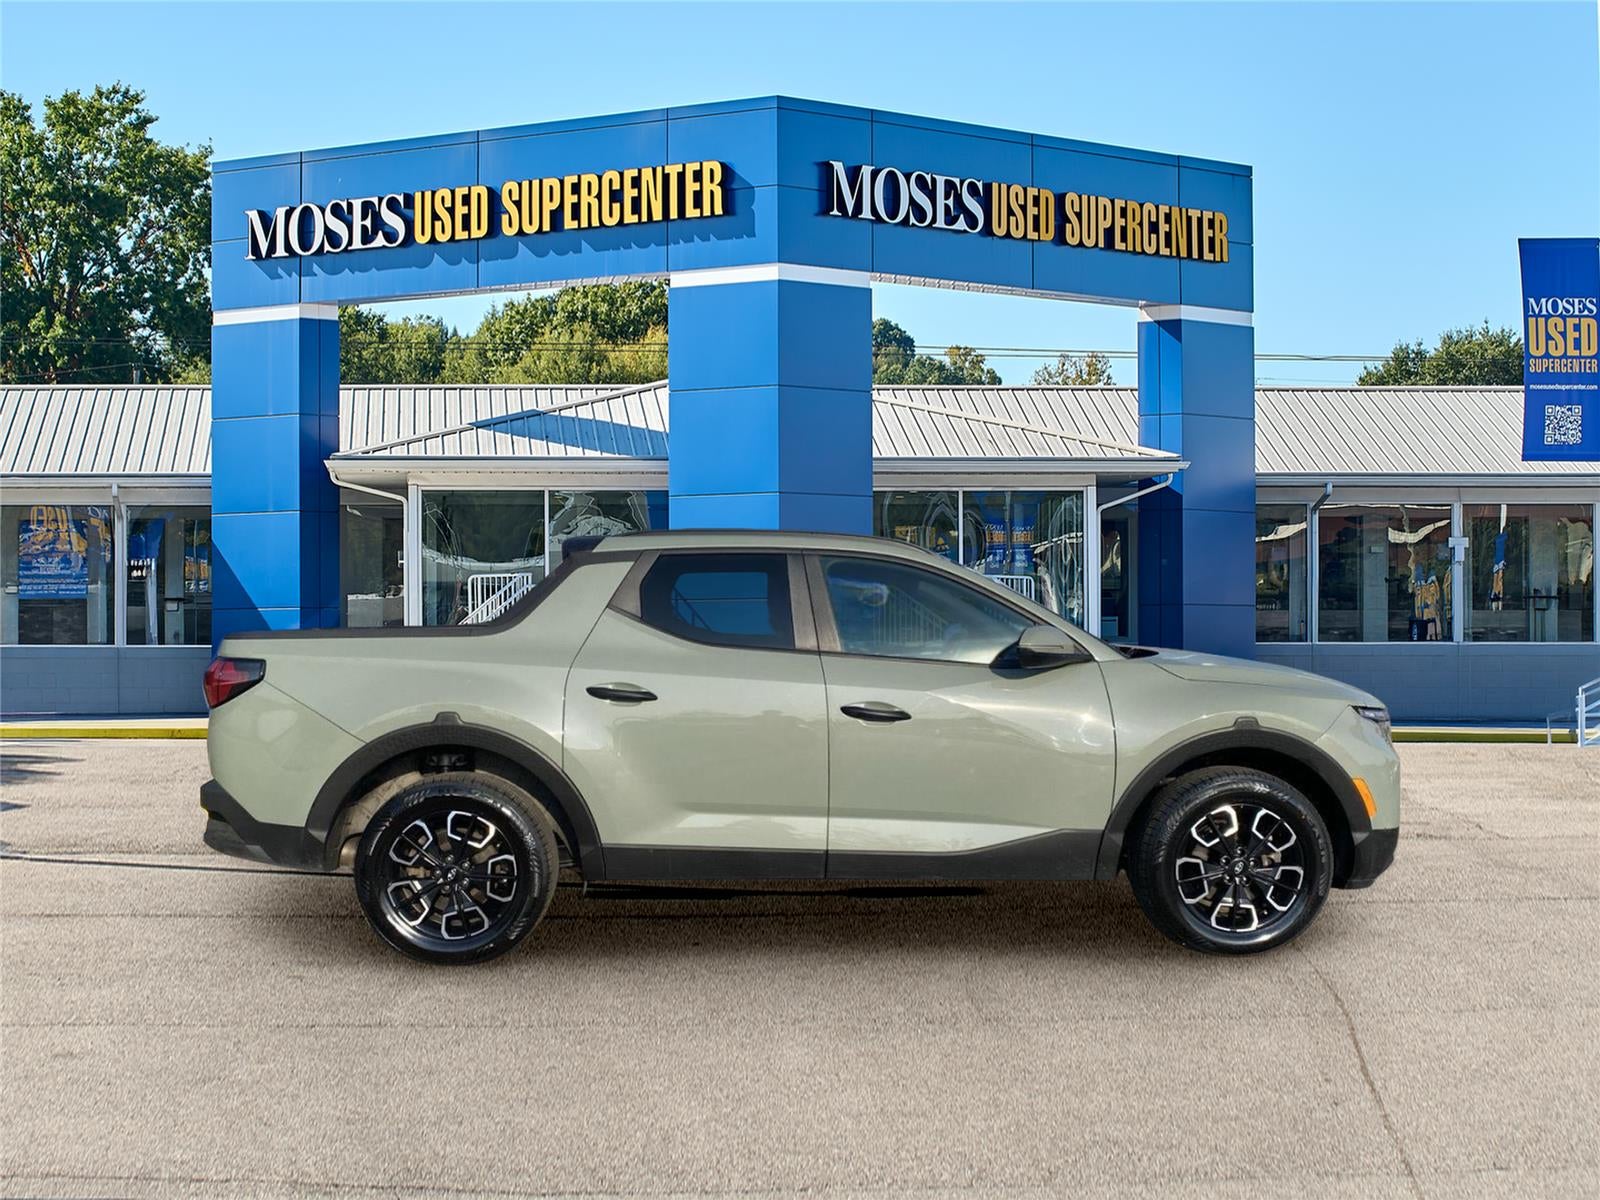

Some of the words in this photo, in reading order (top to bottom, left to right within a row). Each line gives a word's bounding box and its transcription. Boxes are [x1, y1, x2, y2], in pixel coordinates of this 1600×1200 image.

[244, 192, 407, 261] MOSES
[412, 185, 490, 245] USED
[500, 160, 725, 237] SUPERCENTER
[828, 160, 985, 234] MOSES
[991, 181, 1056, 242] USED
[1064, 191, 1230, 263] SUPERCENTER
[1528, 297, 1597, 316] MOSES
[1528, 316, 1598, 356] USED
[1529, 358, 1598, 373] SUPERCENTER
